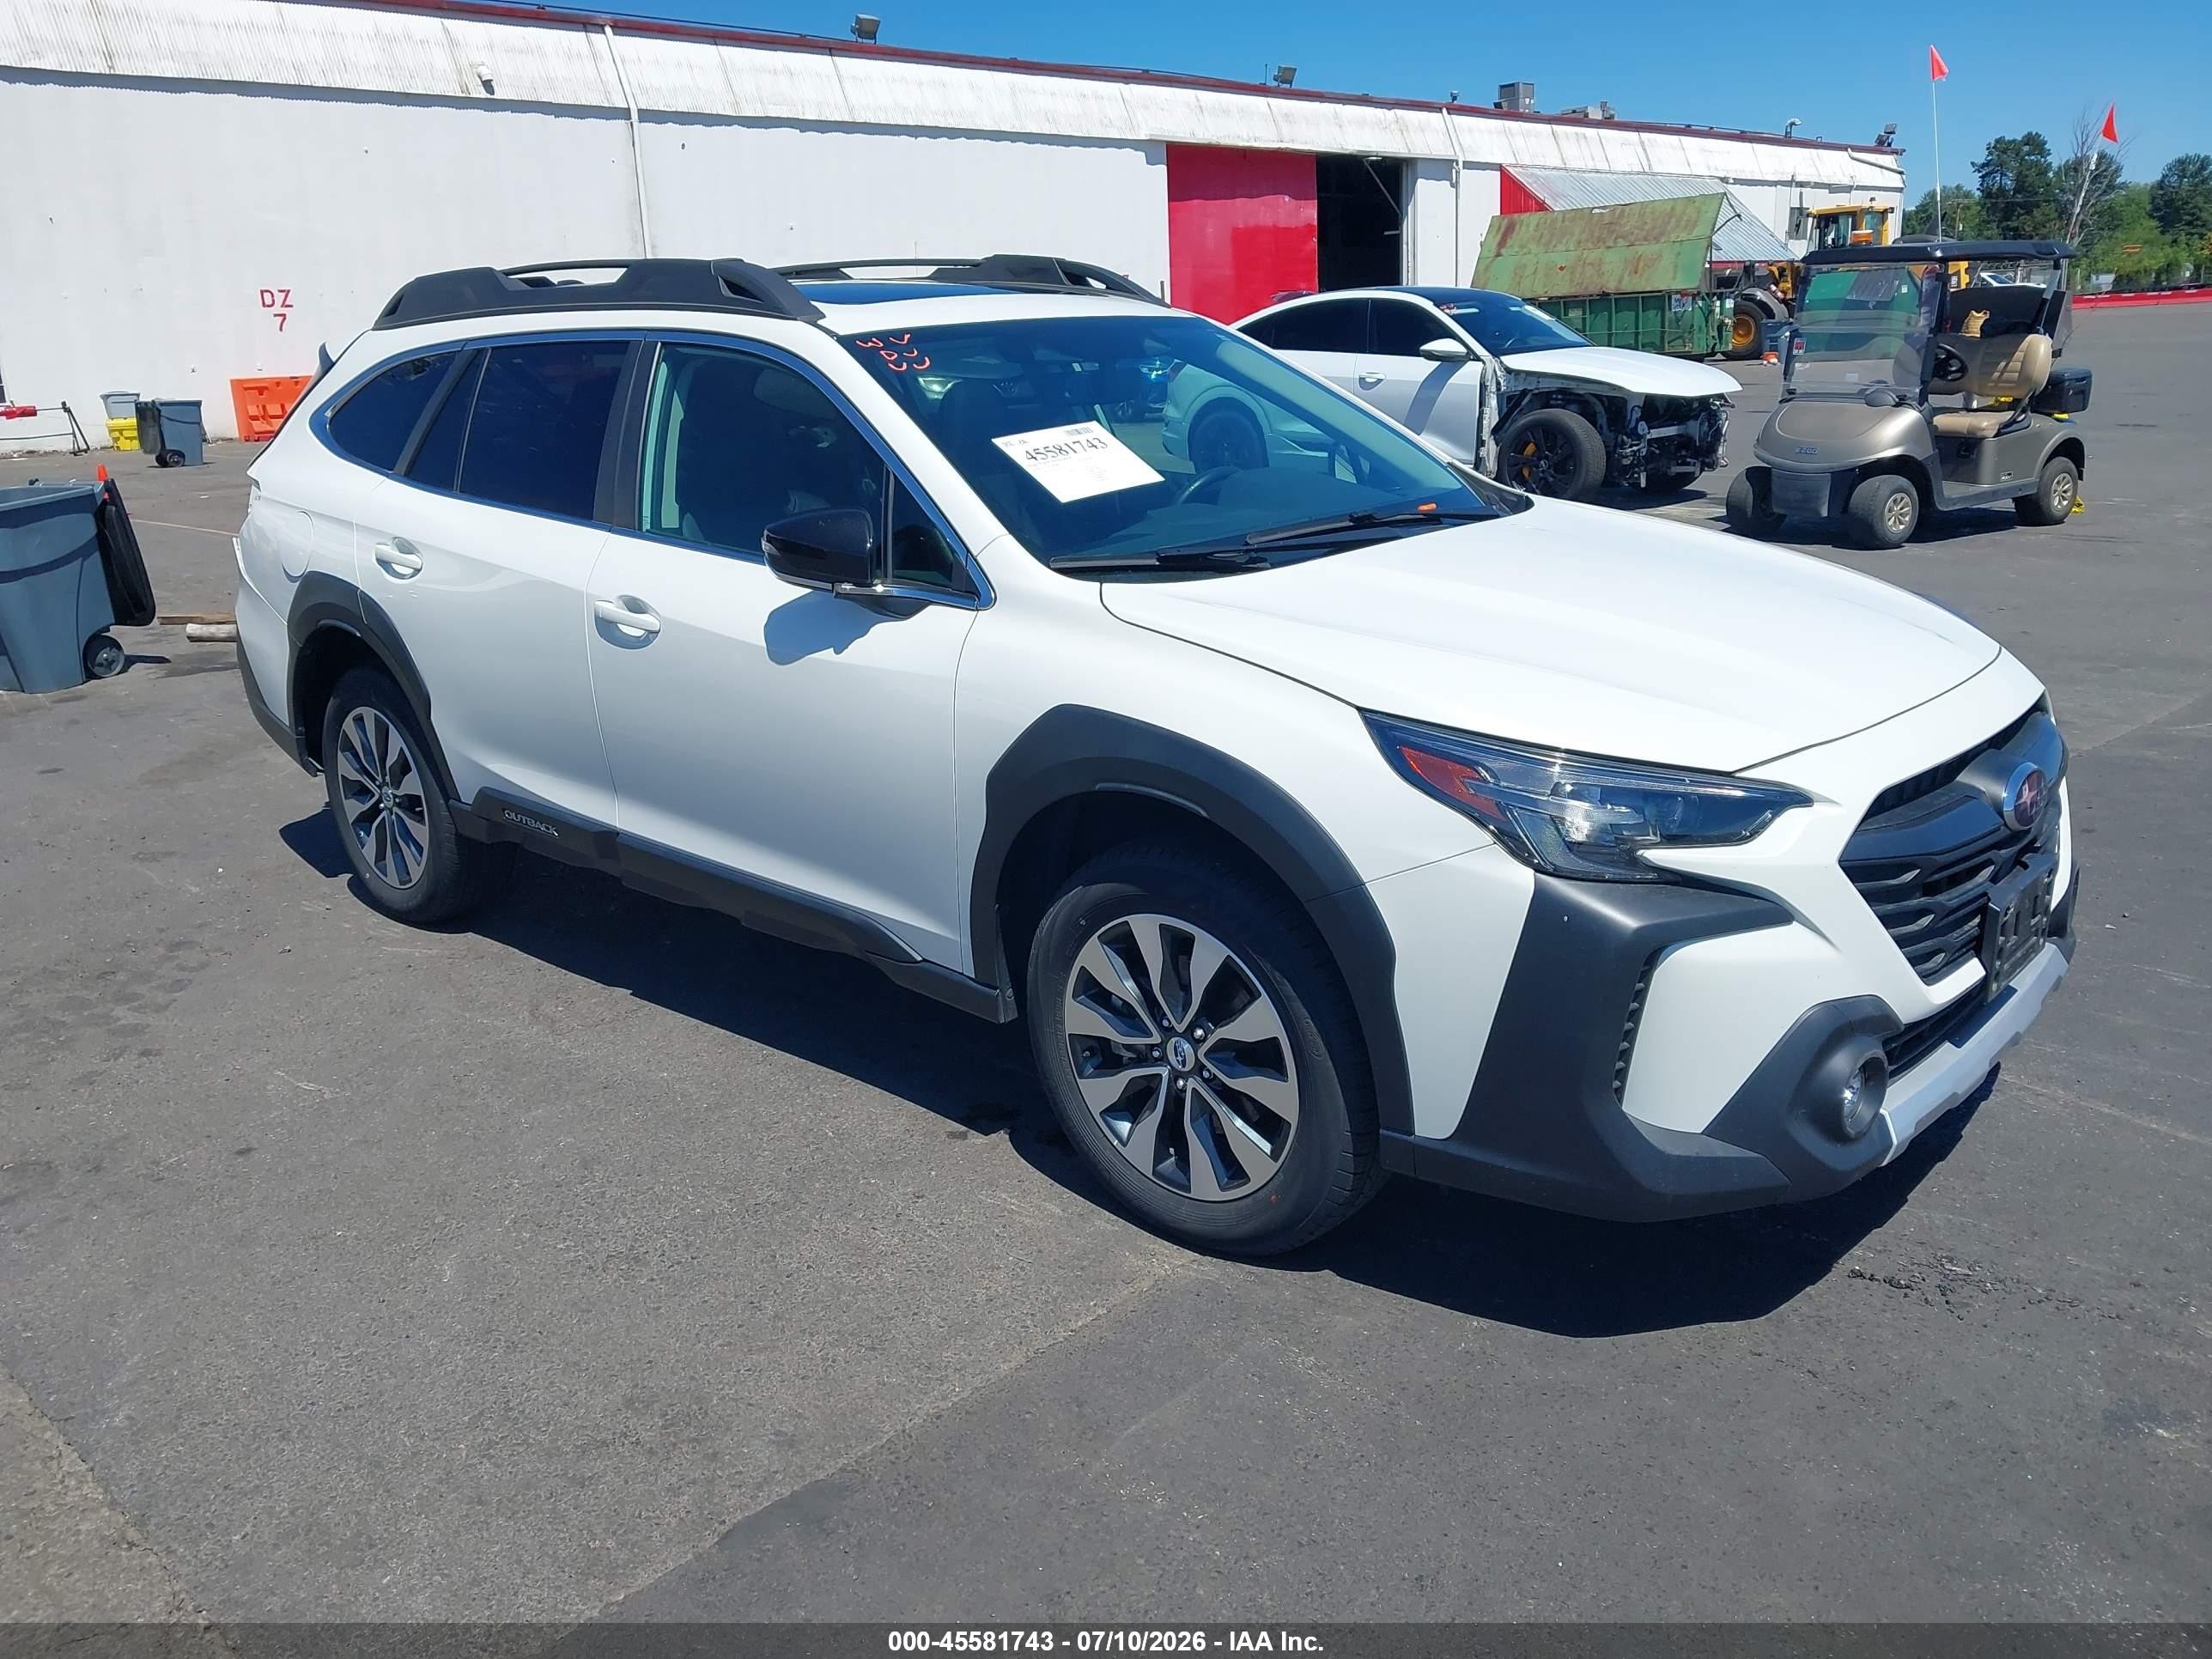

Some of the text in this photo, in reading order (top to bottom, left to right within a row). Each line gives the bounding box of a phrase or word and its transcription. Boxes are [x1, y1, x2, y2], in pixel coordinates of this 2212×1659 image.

[260, 289, 294, 308] DZ
[272, 313, 287, 331] 7
[1025, 437, 1108, 461] 45581743
[504, 810, 559, 836] OUTBACK
